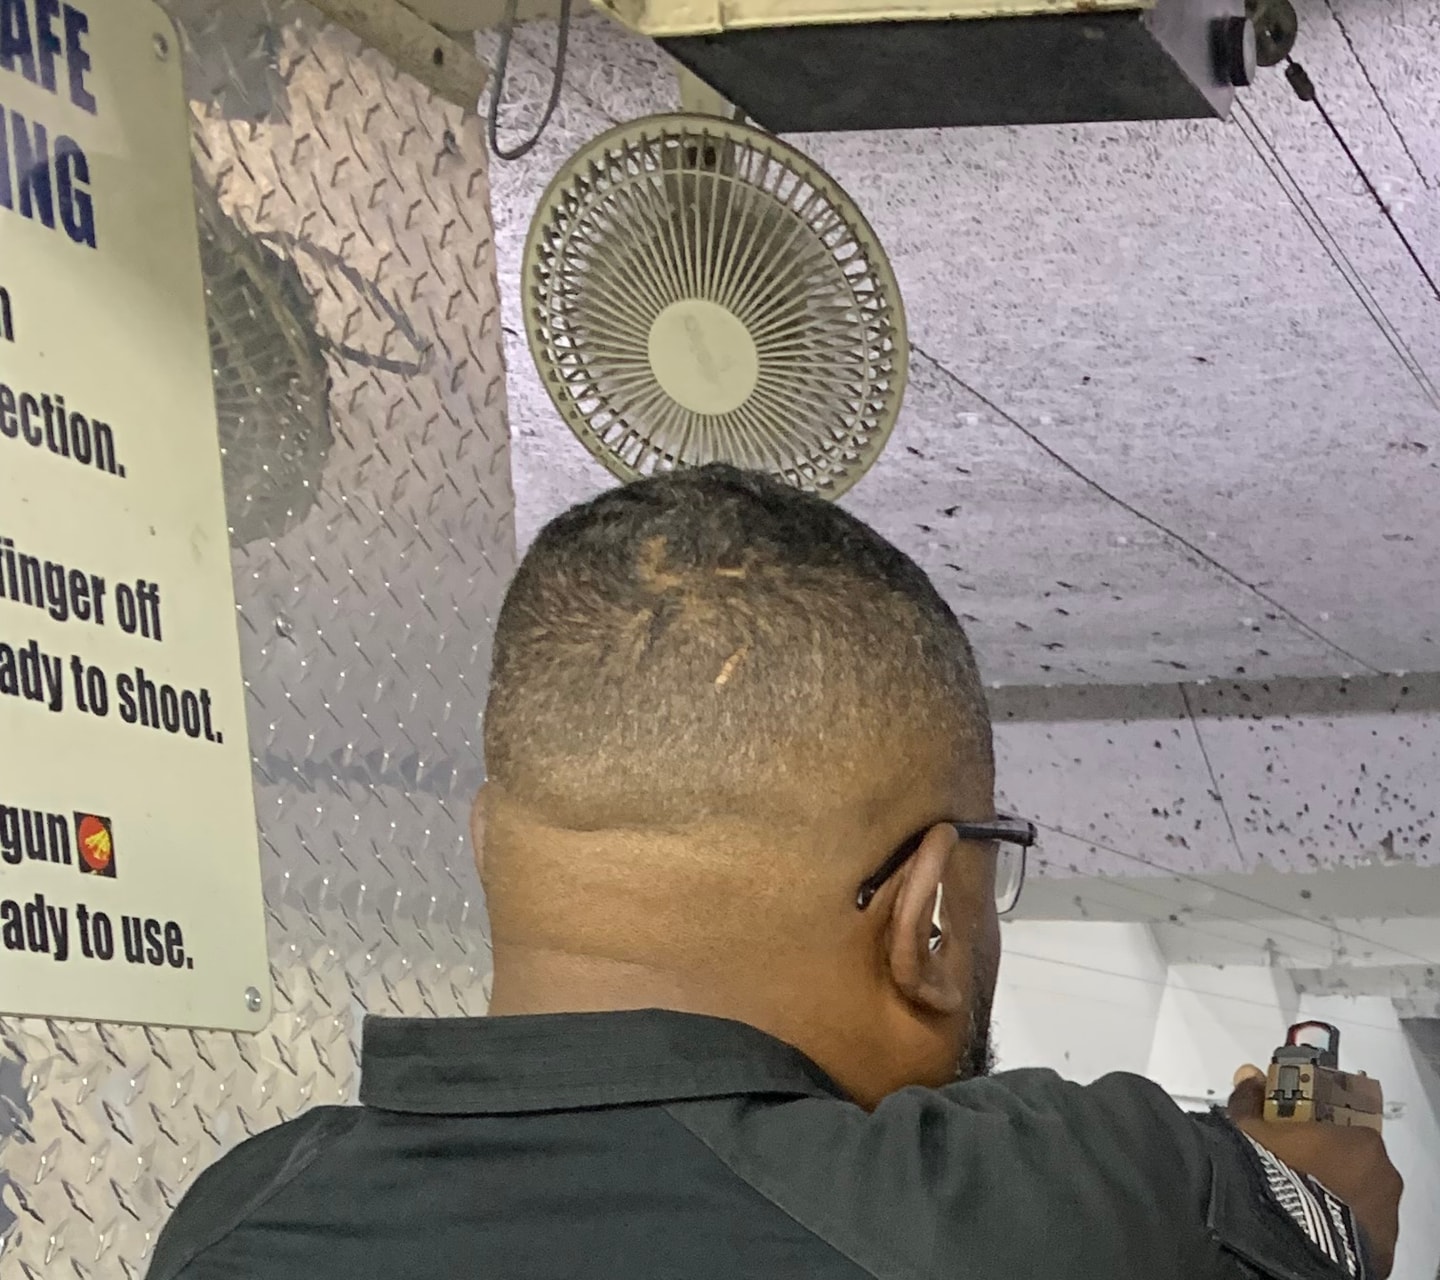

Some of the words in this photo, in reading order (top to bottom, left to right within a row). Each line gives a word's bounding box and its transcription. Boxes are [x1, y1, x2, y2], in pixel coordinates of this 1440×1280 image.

[0, 0, 98, 116] AFE
[0, 382, 126, 478] ection.
[115, 578, 162, 642] off
[70, 654, 109, 717] to
[116, 666, 224, 744] shoot.
[0, 804, 72, 865] gun
[0, 893, 68, 962] ady
[76, 903, 114, 961] to
[121, 915, 194, 970] use.
